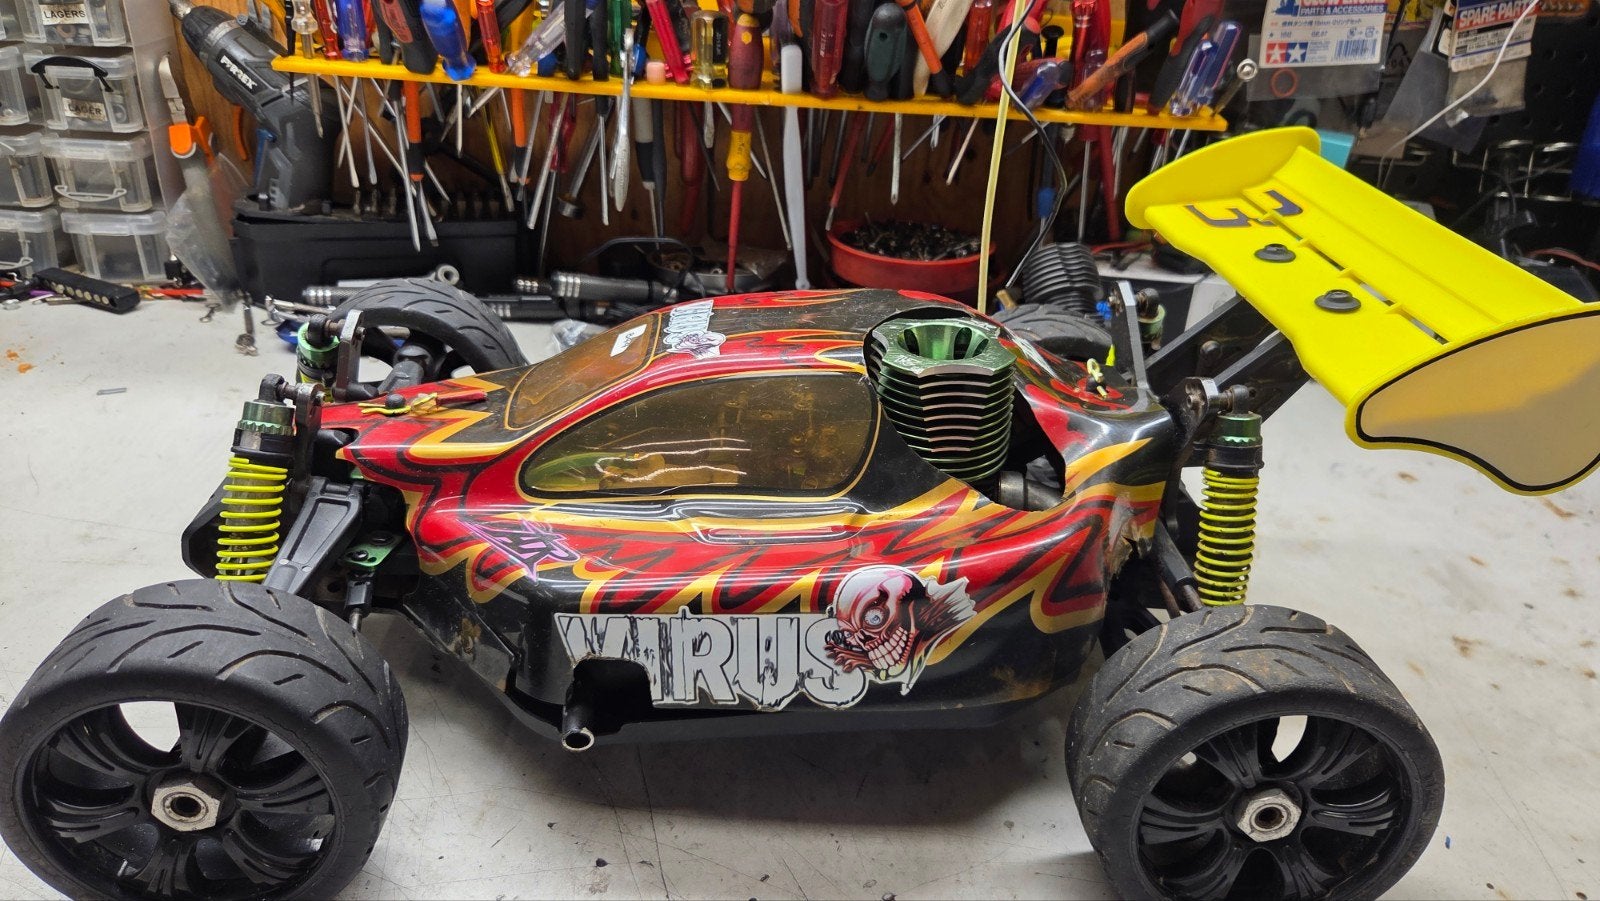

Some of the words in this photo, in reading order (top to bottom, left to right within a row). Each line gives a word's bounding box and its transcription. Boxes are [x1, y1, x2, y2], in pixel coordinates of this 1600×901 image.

[43, 10, 86, 19] LAGERS
[1300, 7, 1326, 15] PARTS
[1333, 4, 1384, 15] ACCESSORIES
[1459, 5, 1497, 27] SPARE
[68, 103, 102, 115] LAGER
[560, 613, 867, 709] VIRUS
